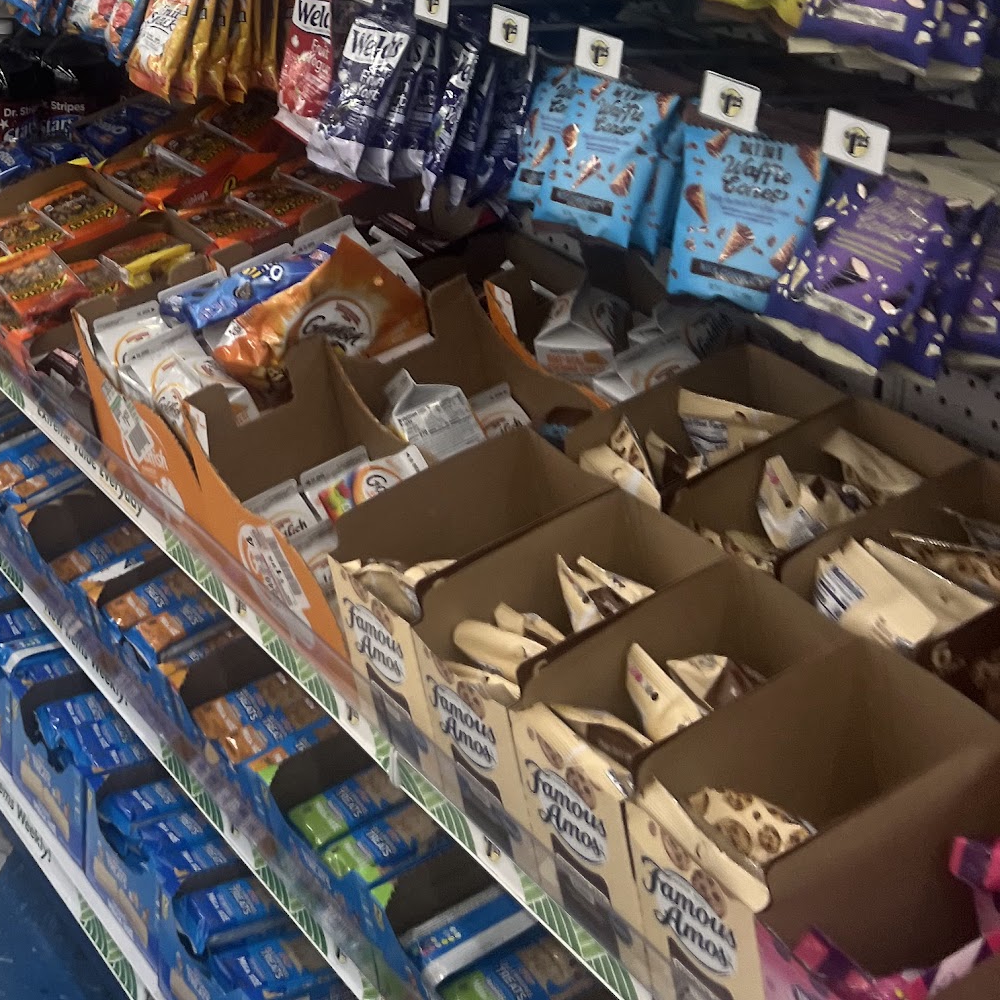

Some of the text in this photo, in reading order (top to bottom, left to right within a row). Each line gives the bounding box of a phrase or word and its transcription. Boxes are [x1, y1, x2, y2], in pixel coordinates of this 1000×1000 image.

[3, 108, 18, 118] Dr.
[51, 101, 86, 113] Stripes
[720, 155, 793, 187] Waffle
[342, 598, 404, 654] Famous
[354, 631, 404, 674] Amos
[428, 673, 496, 745] Famous
[439, 715, 496, 763] Amos
[525, 759, 607, 837] Famous
[16, 801, 52, 863] Weekly!
[538, 802, 605, 855] Amos
[641, 855, 737, 947] Famous
[653, 903, 733, 967] Amos
